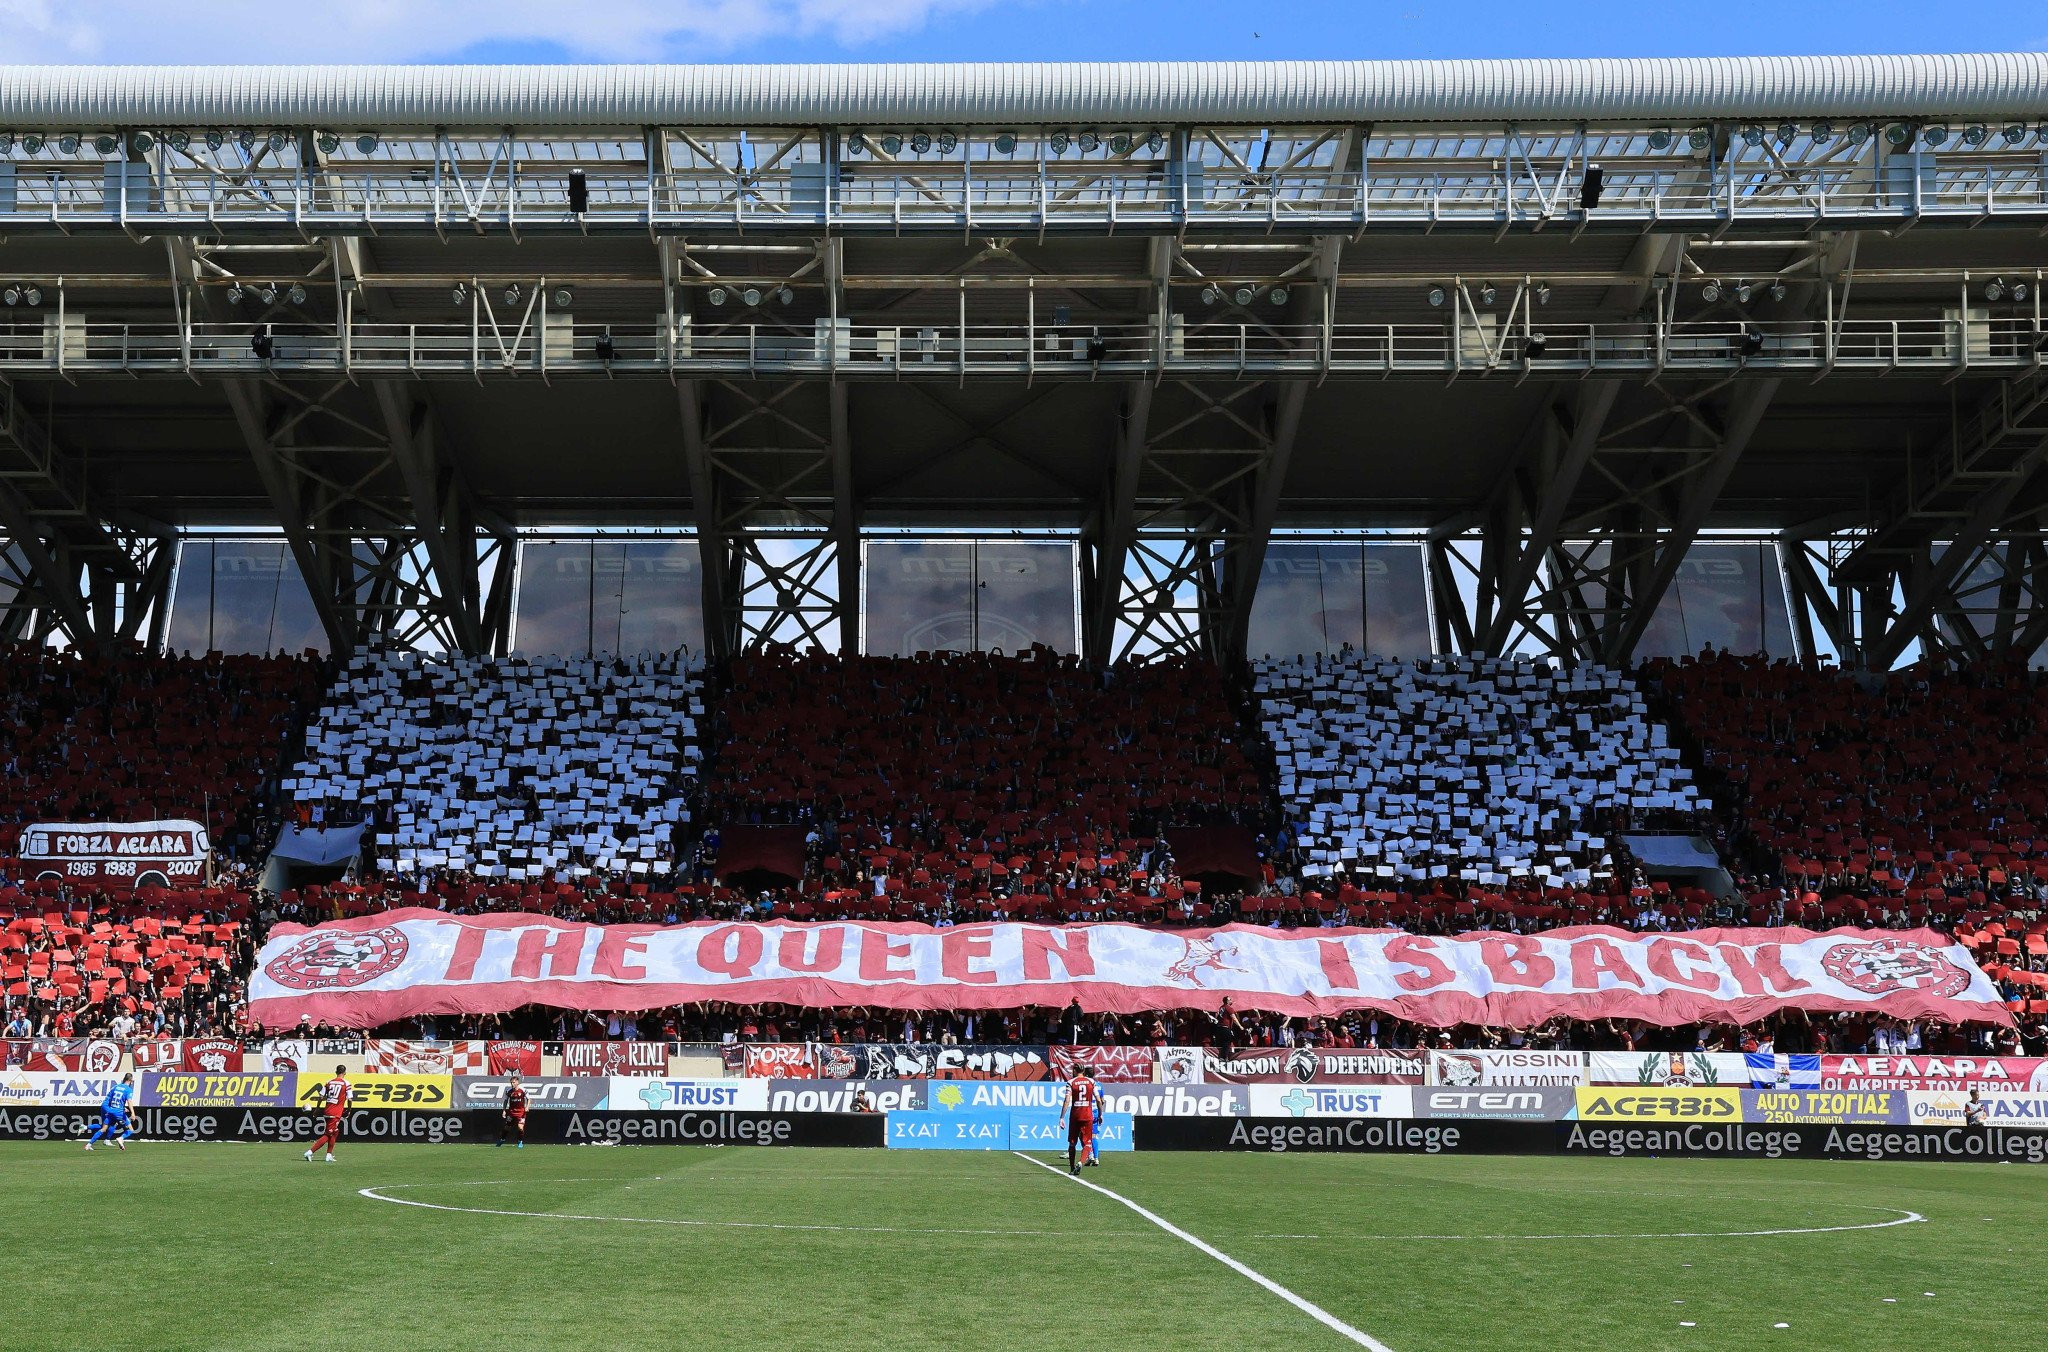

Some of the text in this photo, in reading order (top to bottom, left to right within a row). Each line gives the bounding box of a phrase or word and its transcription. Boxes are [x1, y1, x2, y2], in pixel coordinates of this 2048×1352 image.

[57, 834, 113, 854] FORZA
[67, 860, 203, 876] 1985 1988 2007
[437, 920, 655, 980] THE
[696, 924, 1096, 984] QUEEN
[1317, 935, 1456, 991] IS
[1481, 937, 1812, 996] BACK
[192, 1041, 239, 1055] MONSTERS
[566, 1042, 665, 1067] KATE RINI
[826, 1062, 855, 1075] CRIMSON
[1203, 1055, 1423, 1076] CRIMSON DEFENDERS
[1487, 1054, 1578, 1067] VISSINI
[155, 1076, 284, 1097] AUTO ΤΣΟΓΙΑΣ
[328, 1084, 342, 1099] 20
[467, 1082, 577, 1099] ETEM
[666, 1082, 738, 1105] TRUST
[972, 1085, 1072, 1108] ANIMUS
[1078, 1084, 1087, 1101] 2
[161, 1093, 189, 1106] 250
[189, 1097, 235, 1107] ΑΥΤΟΚΙΝΗΤΑ
[1100, 1087, 1236, 1117] novibet
[1307, 1088, 1381, 1112] TRUST
[1430, 1092, 1543, 1109] ETEM
[1756, 1094, 1891, 1115] AUTO ΤΣΟΓΙΑΣ
[1764, 1111, 1793, 1124] 250
[1794, 1115, 1844, 1124] ΑΥΤΟΚΙΝΗΤΑ
[566, 1111, 792, 1146] AegeanCollege
[1229, 1119, 1460, 1152] AegeanCollege
[1567, 1123, 1802, 1157] AegeanCollege
